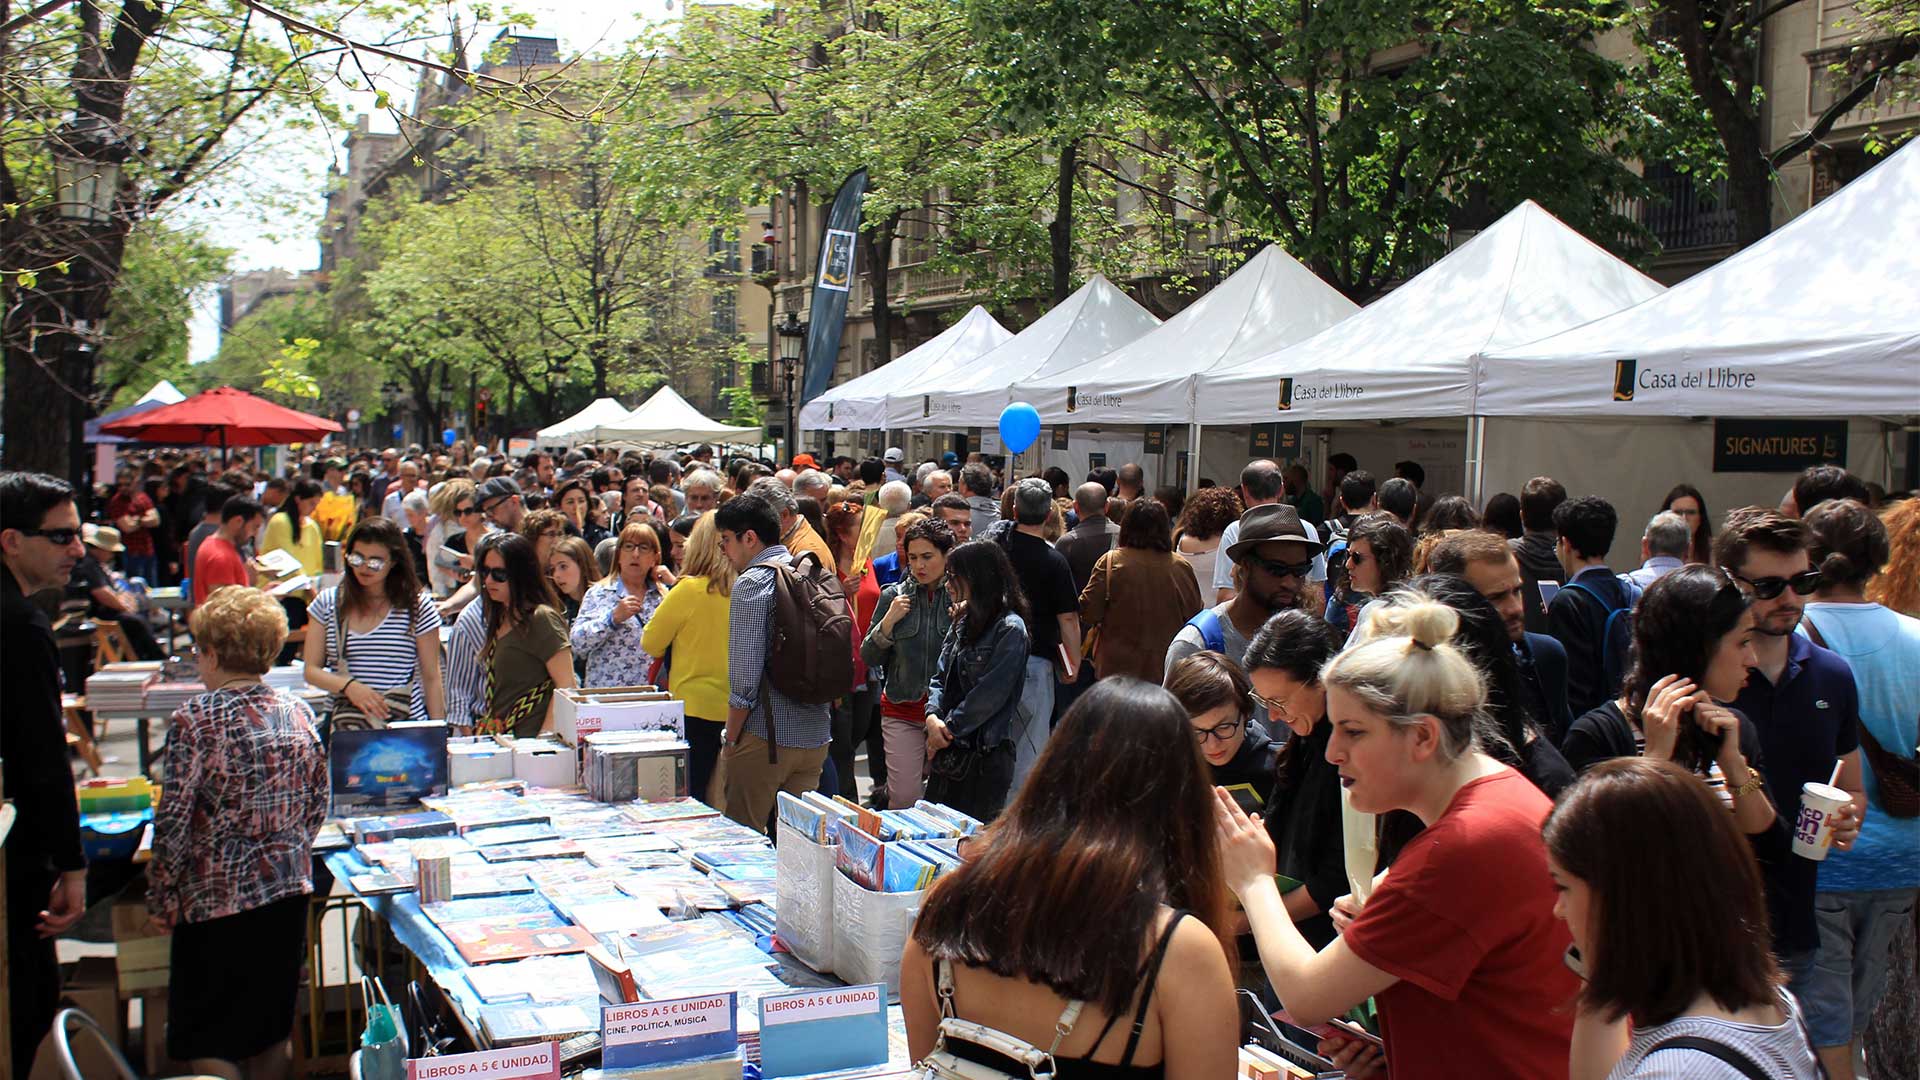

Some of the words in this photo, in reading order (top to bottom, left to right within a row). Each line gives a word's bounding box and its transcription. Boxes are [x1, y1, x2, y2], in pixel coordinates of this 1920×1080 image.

[1638, 368, 1677, 389] Casa
[1681, 371, 1702, 389] del
[1707, 367, 1756, 389] Llibre
[1293, 384, 1317, 401] Casa
[1318, 386, 1332, 399] del
[1334, 383, 1364, 399] Llibre
[1725, 436, 1817, 456] SIGNATURES
[606, 1008, 649, 1023] LIBROS
[651, 1007, 660, 1017] A
[662, 1005, 669, 1015] 5
[671, 1004, 678, 1014] €
[681, 998, 726, 1012] UNIDAD.
[765, 999, 805, 1013] LIBROS
[807, 998, 815, 1007] A
[818, 996, 824, 1006] 5
[826, 995, 833, 1005] €
[835, 991, 878, 1004] UNIDAD.
[606, 1025, 629, 1036] CINE,
[418, 1064, 466, 1079] LIBROS
[469, 1063, 478, 1073] A
[481, 1061, 488, 1072] 5
[491, 1060, 498, 1070] €
[502, 1054, 551, 1069] UNIDAD.
